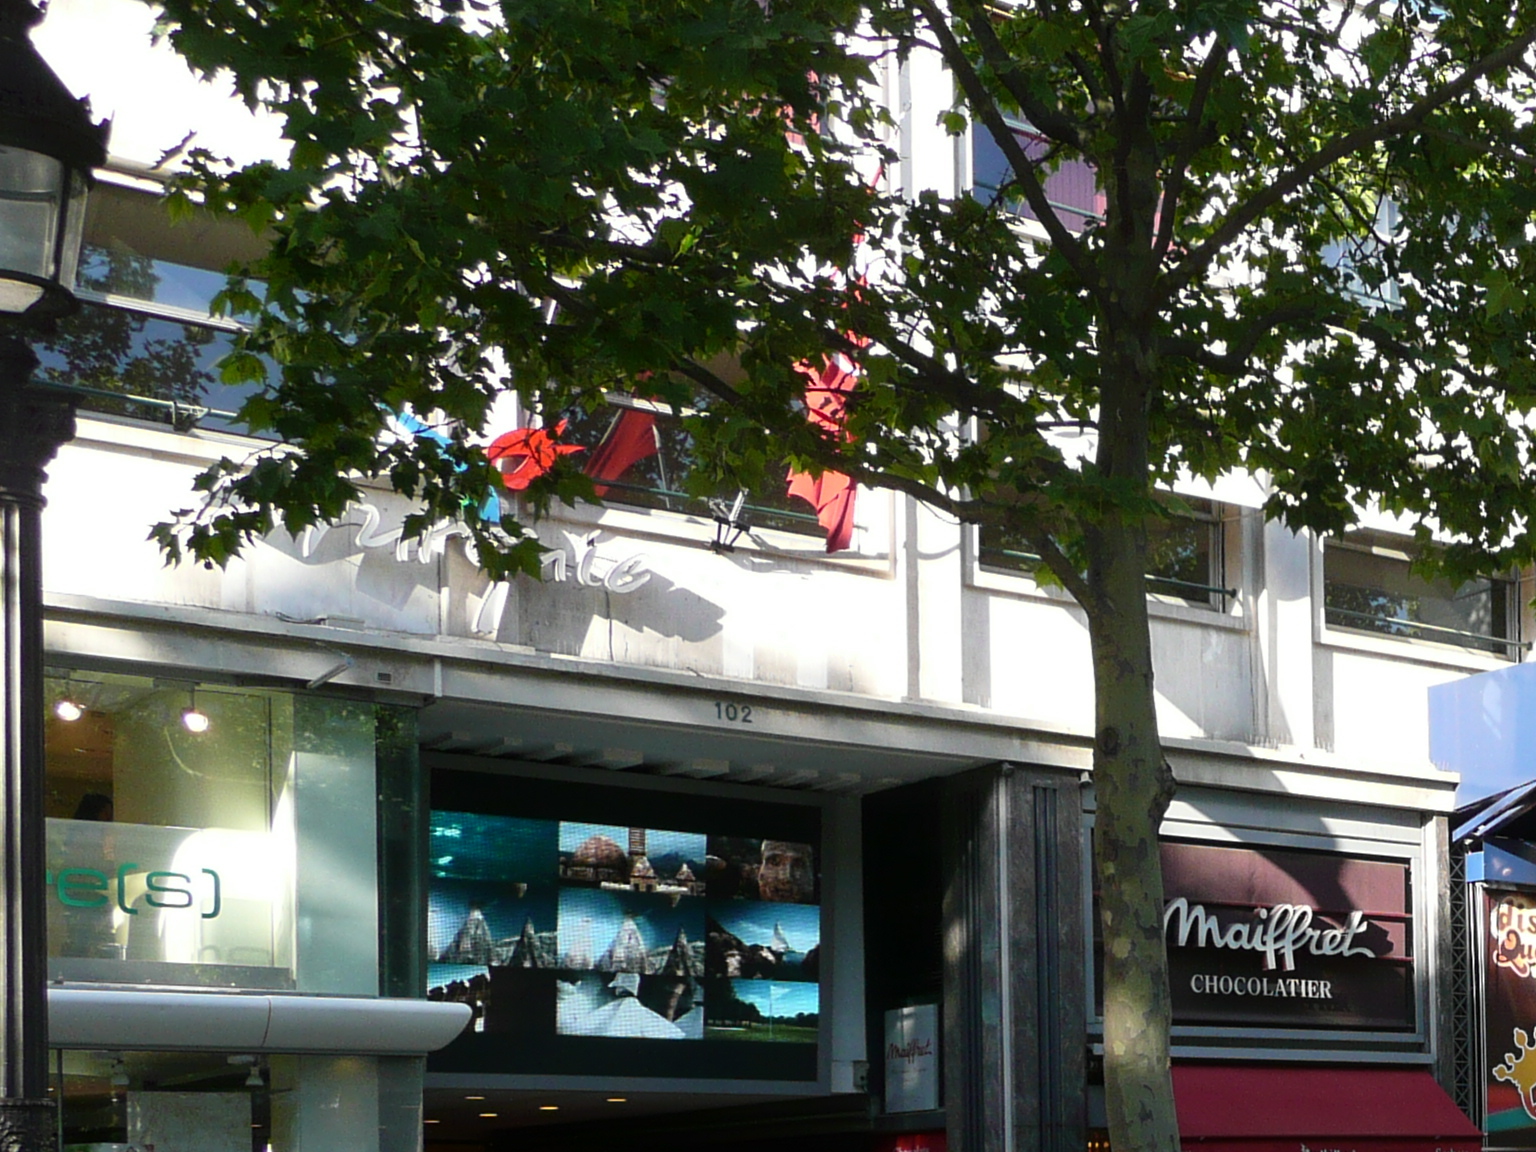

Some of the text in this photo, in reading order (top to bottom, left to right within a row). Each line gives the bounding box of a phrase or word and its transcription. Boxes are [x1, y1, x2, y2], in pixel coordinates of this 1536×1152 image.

[714, 701, 753, 723] 102
[46, 863, 221, 919] e(s)
[1164, 897, 1376, 971] Maiffret
[1190, 974, 1333, 999] CHOCOLATIER
